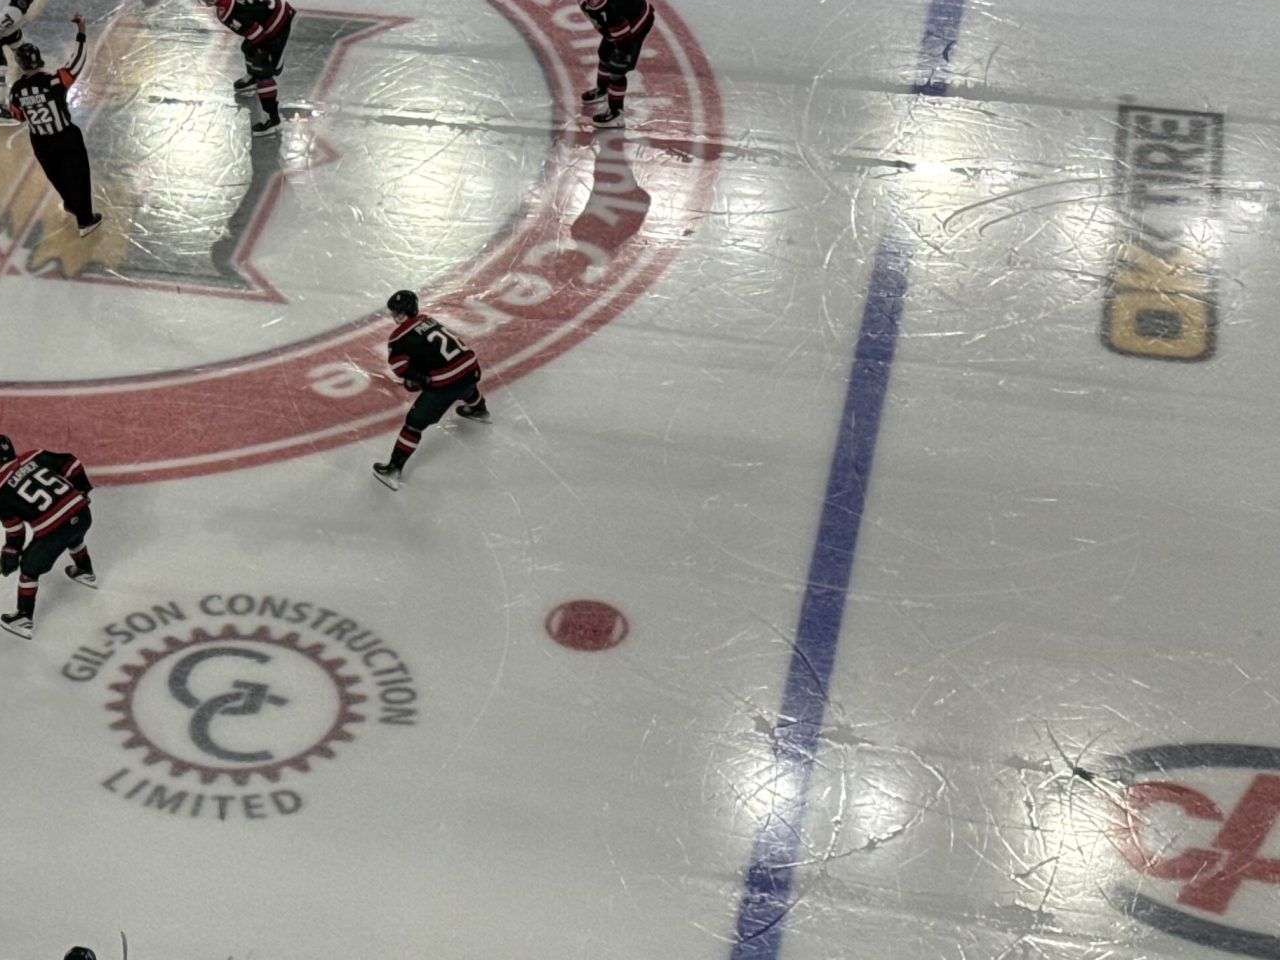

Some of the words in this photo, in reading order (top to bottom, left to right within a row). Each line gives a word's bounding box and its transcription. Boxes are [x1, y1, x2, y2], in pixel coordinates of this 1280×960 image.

[27, 107, 53, 125] 22
[1132, 113, 1208, 211] TIRE
[308, 240, 611, 399] Cene
[427, 326, 467, 362] 2
[17, 467, 70, 512] 55
[60, 600, 188, 683] GIL-SON
[198, 593, 419, 727] CONSTRUCTION
[100, 767, 304, 821] LIMITED
